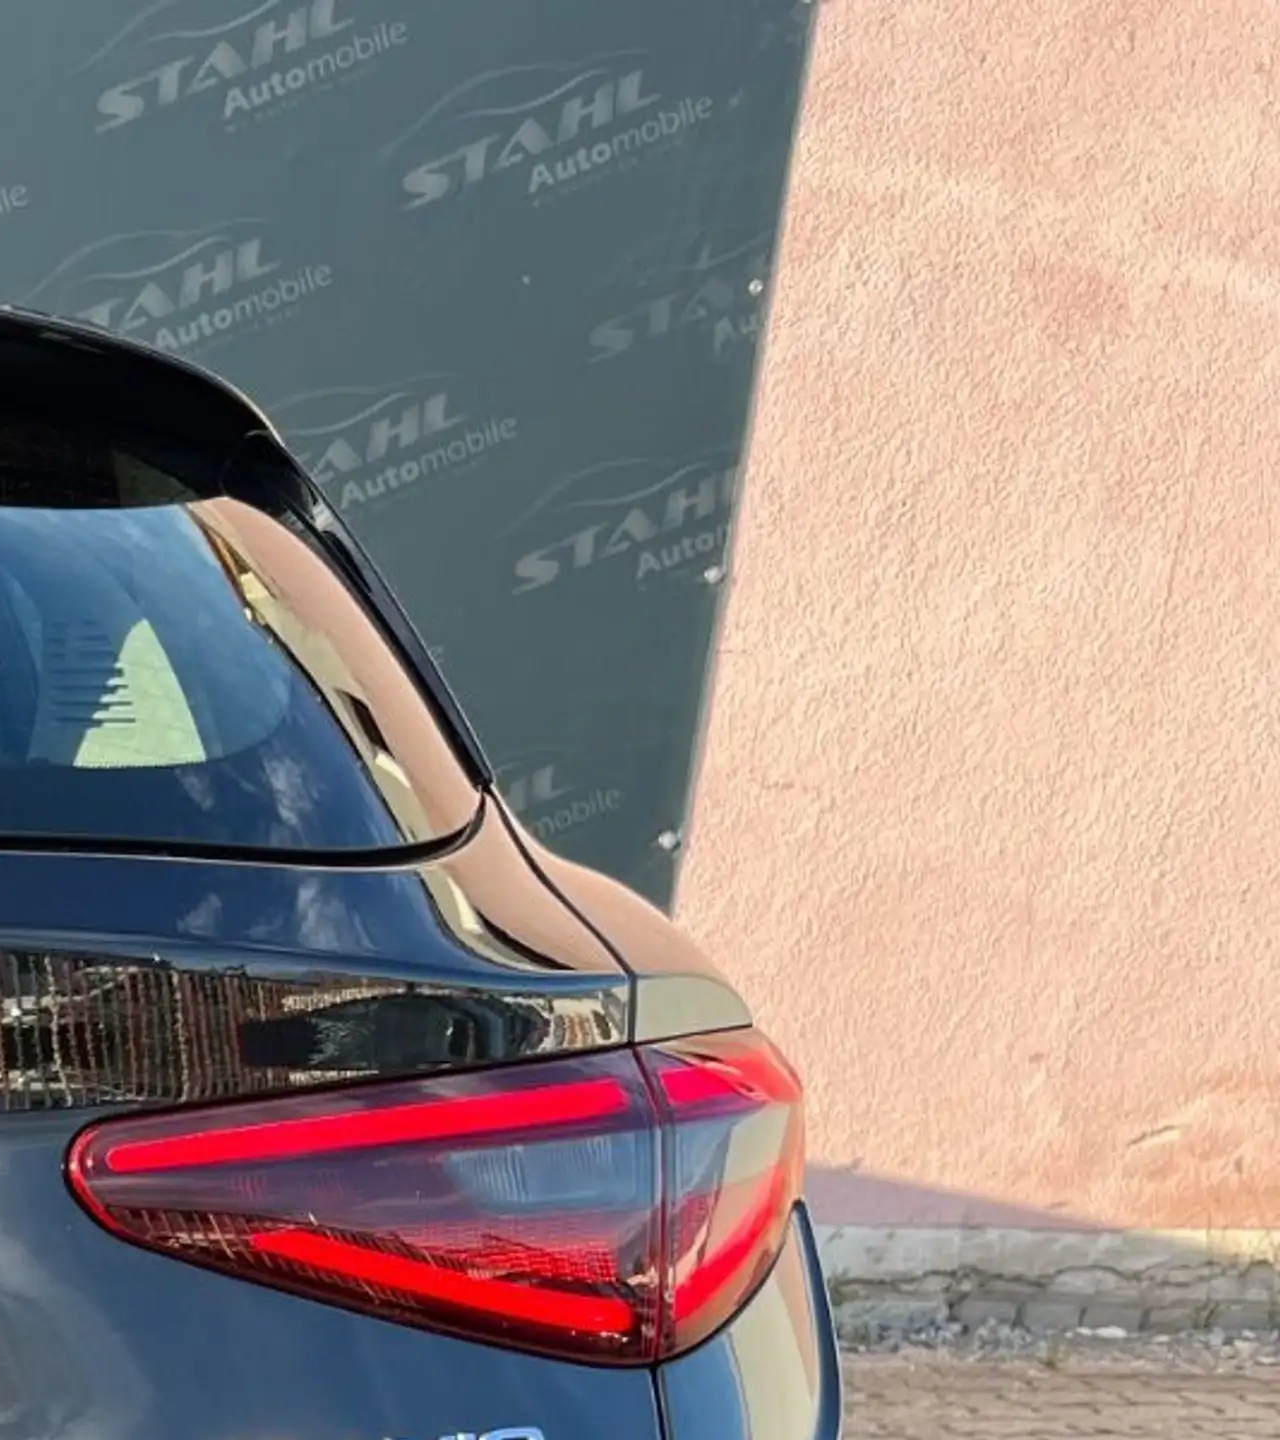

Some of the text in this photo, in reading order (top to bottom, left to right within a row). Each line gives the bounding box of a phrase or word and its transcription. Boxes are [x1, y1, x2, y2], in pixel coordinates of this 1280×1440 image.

[95, 0, 355, 135] STAHL
[223, 20, 408, 121] Automobile
[398, 70, 662, 213] STAHL
[528, 95, 716, 196] Automobile
[152, 262, 334, 352] Automobile
[340, 416, 519, 509] Automobile
